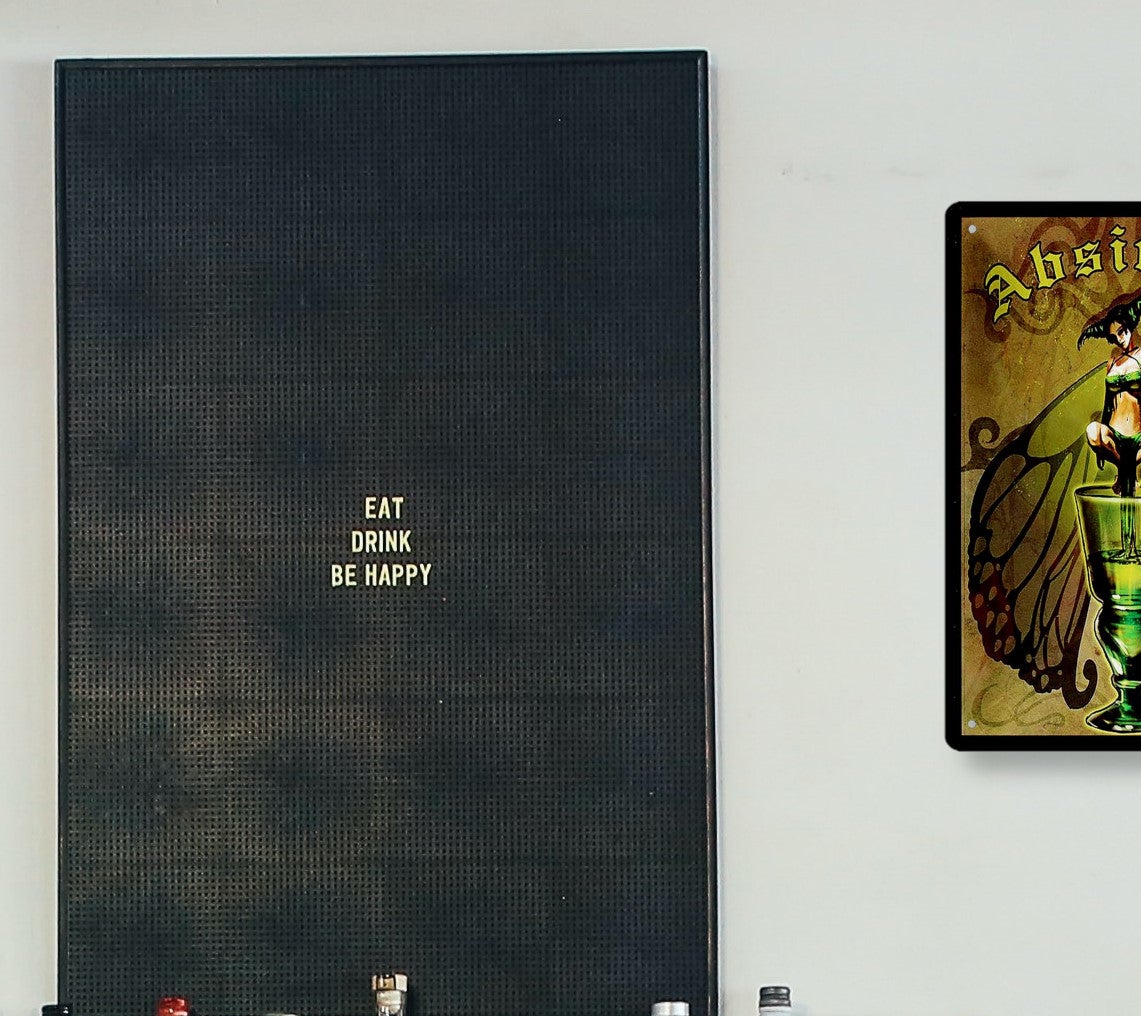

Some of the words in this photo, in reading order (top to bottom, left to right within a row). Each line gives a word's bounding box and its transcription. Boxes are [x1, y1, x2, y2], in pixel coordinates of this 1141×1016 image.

[365, 496, 404, 520] EAT
[351, 529, 412, 553] DRINK
[331, 563, 357, 587] BE
[365, 562, 432, 587] HAPPY
